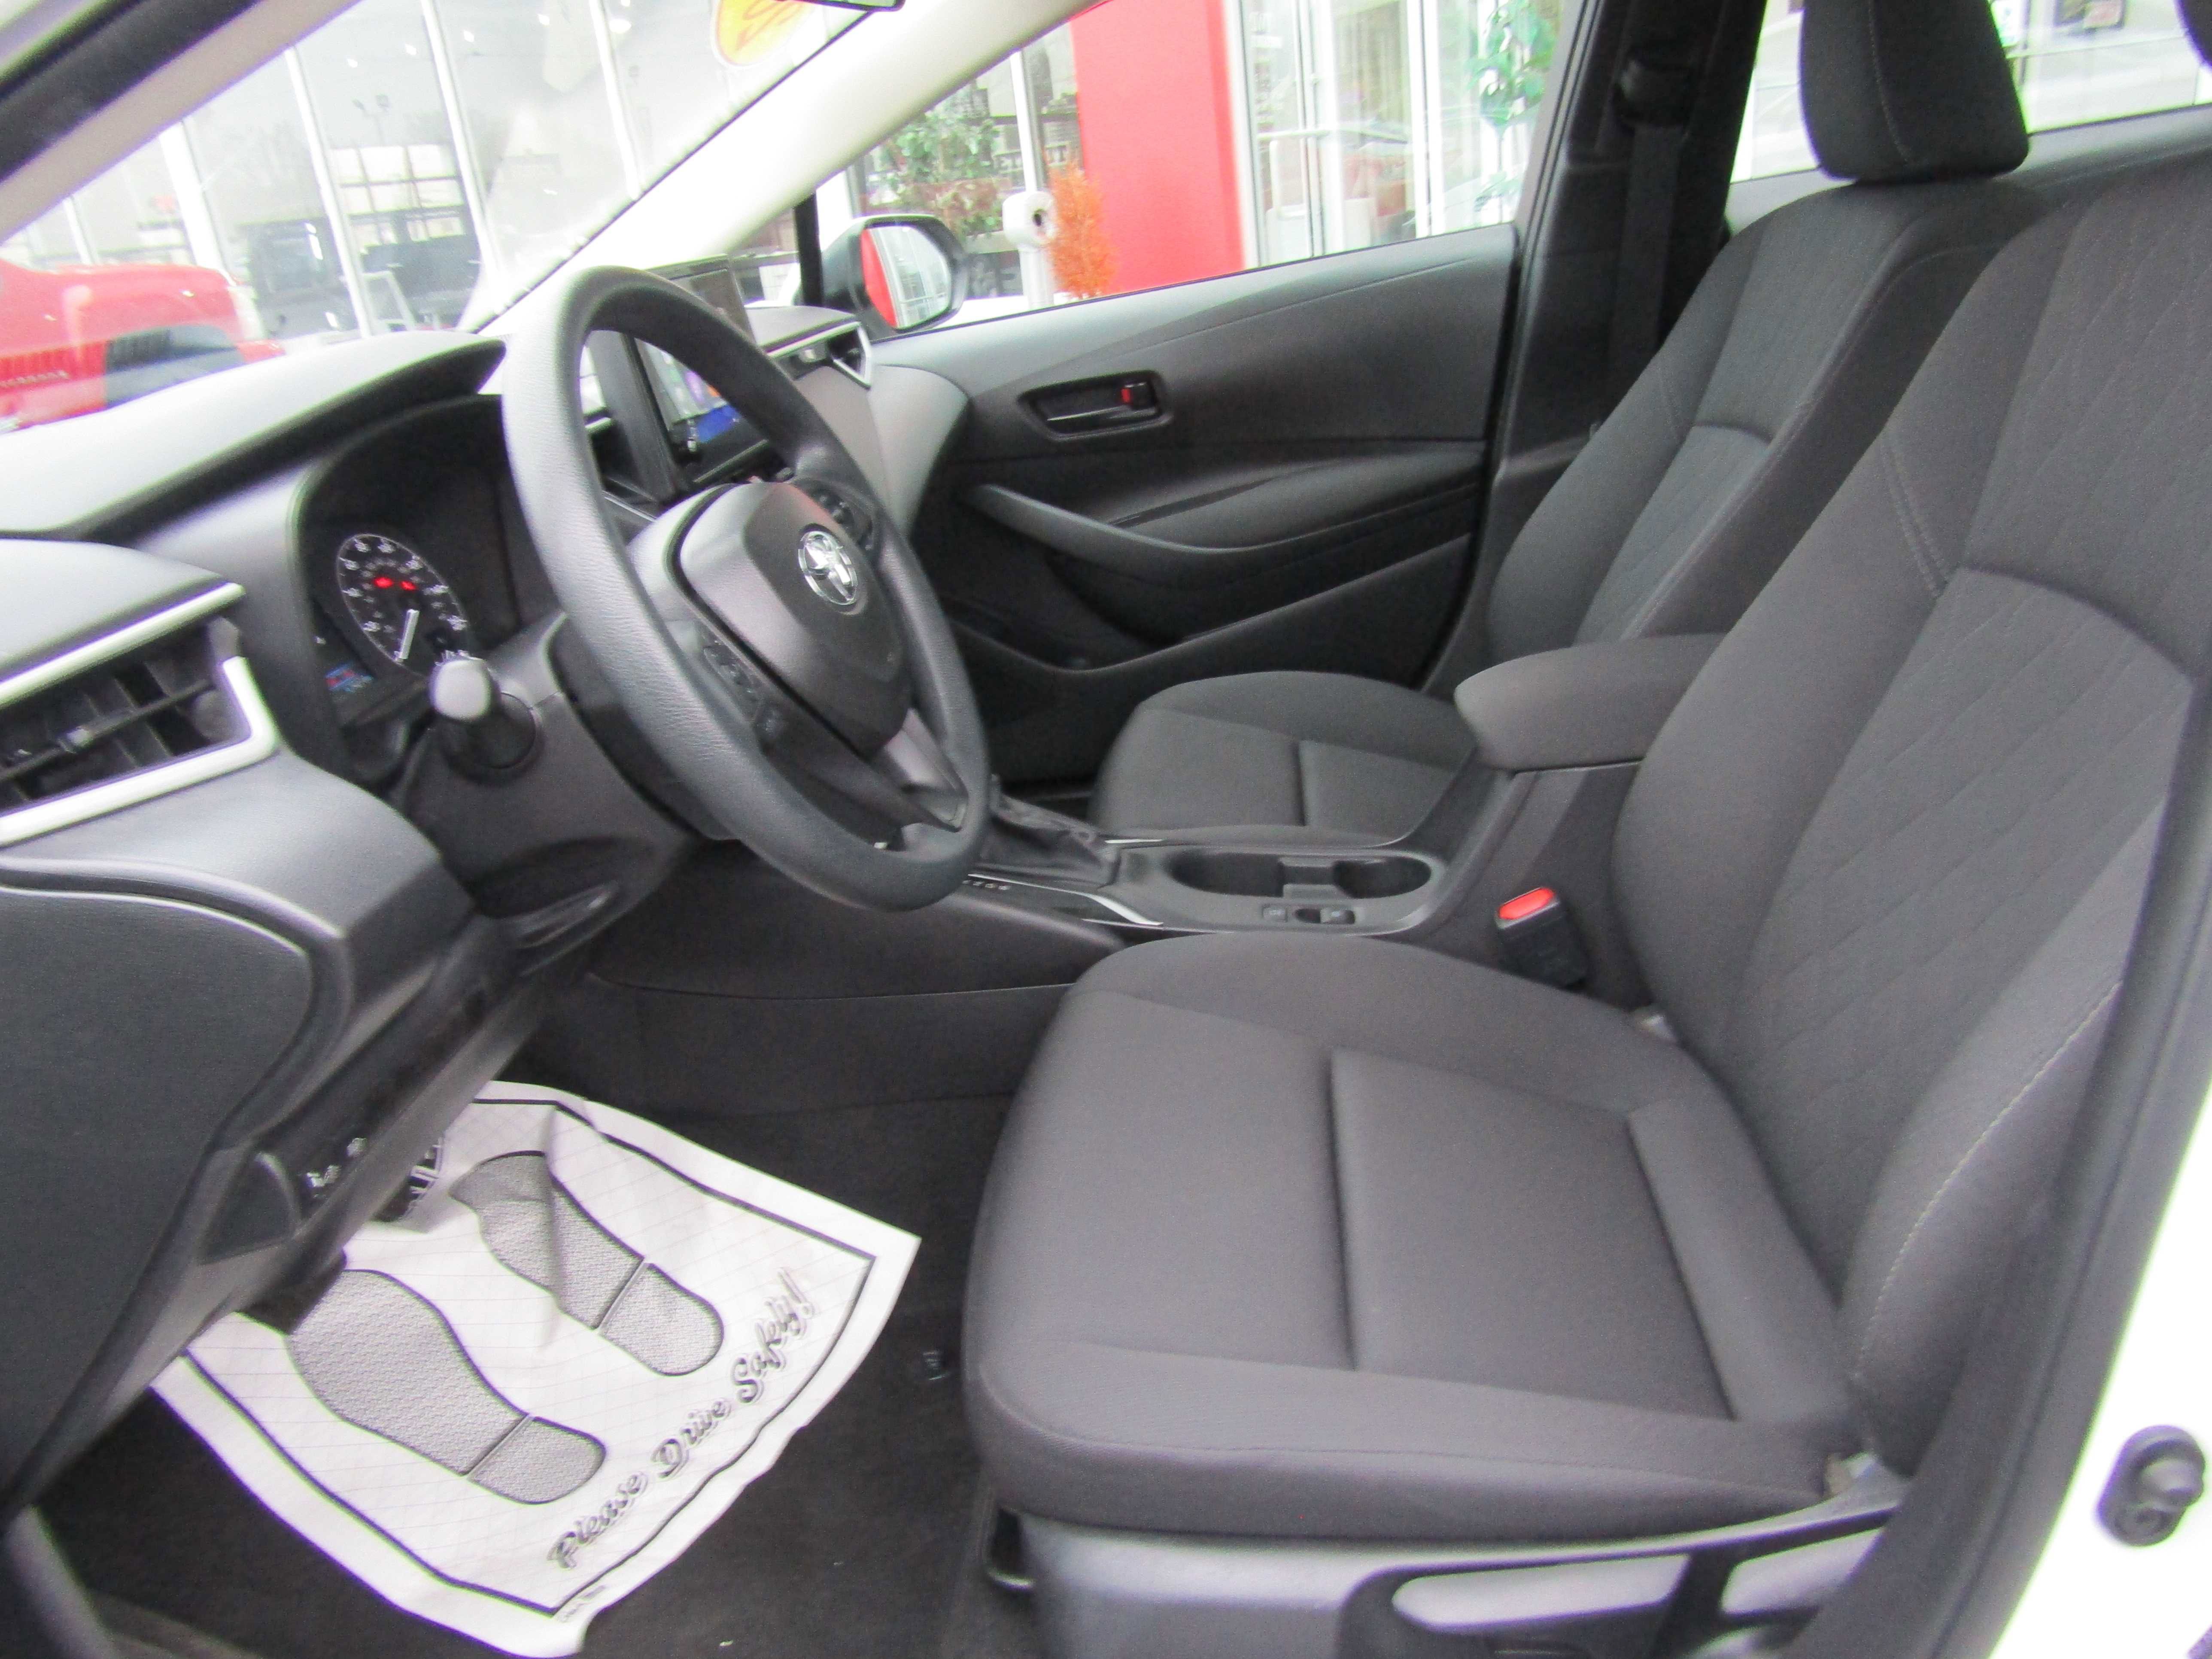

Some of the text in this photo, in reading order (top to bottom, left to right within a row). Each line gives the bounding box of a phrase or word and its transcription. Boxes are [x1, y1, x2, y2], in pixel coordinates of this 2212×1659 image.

[547, 1472, 647, 1569] Please
[650, 1399, 731, 1478] Drive
[731, 1267, 815, 1403] Safely!
